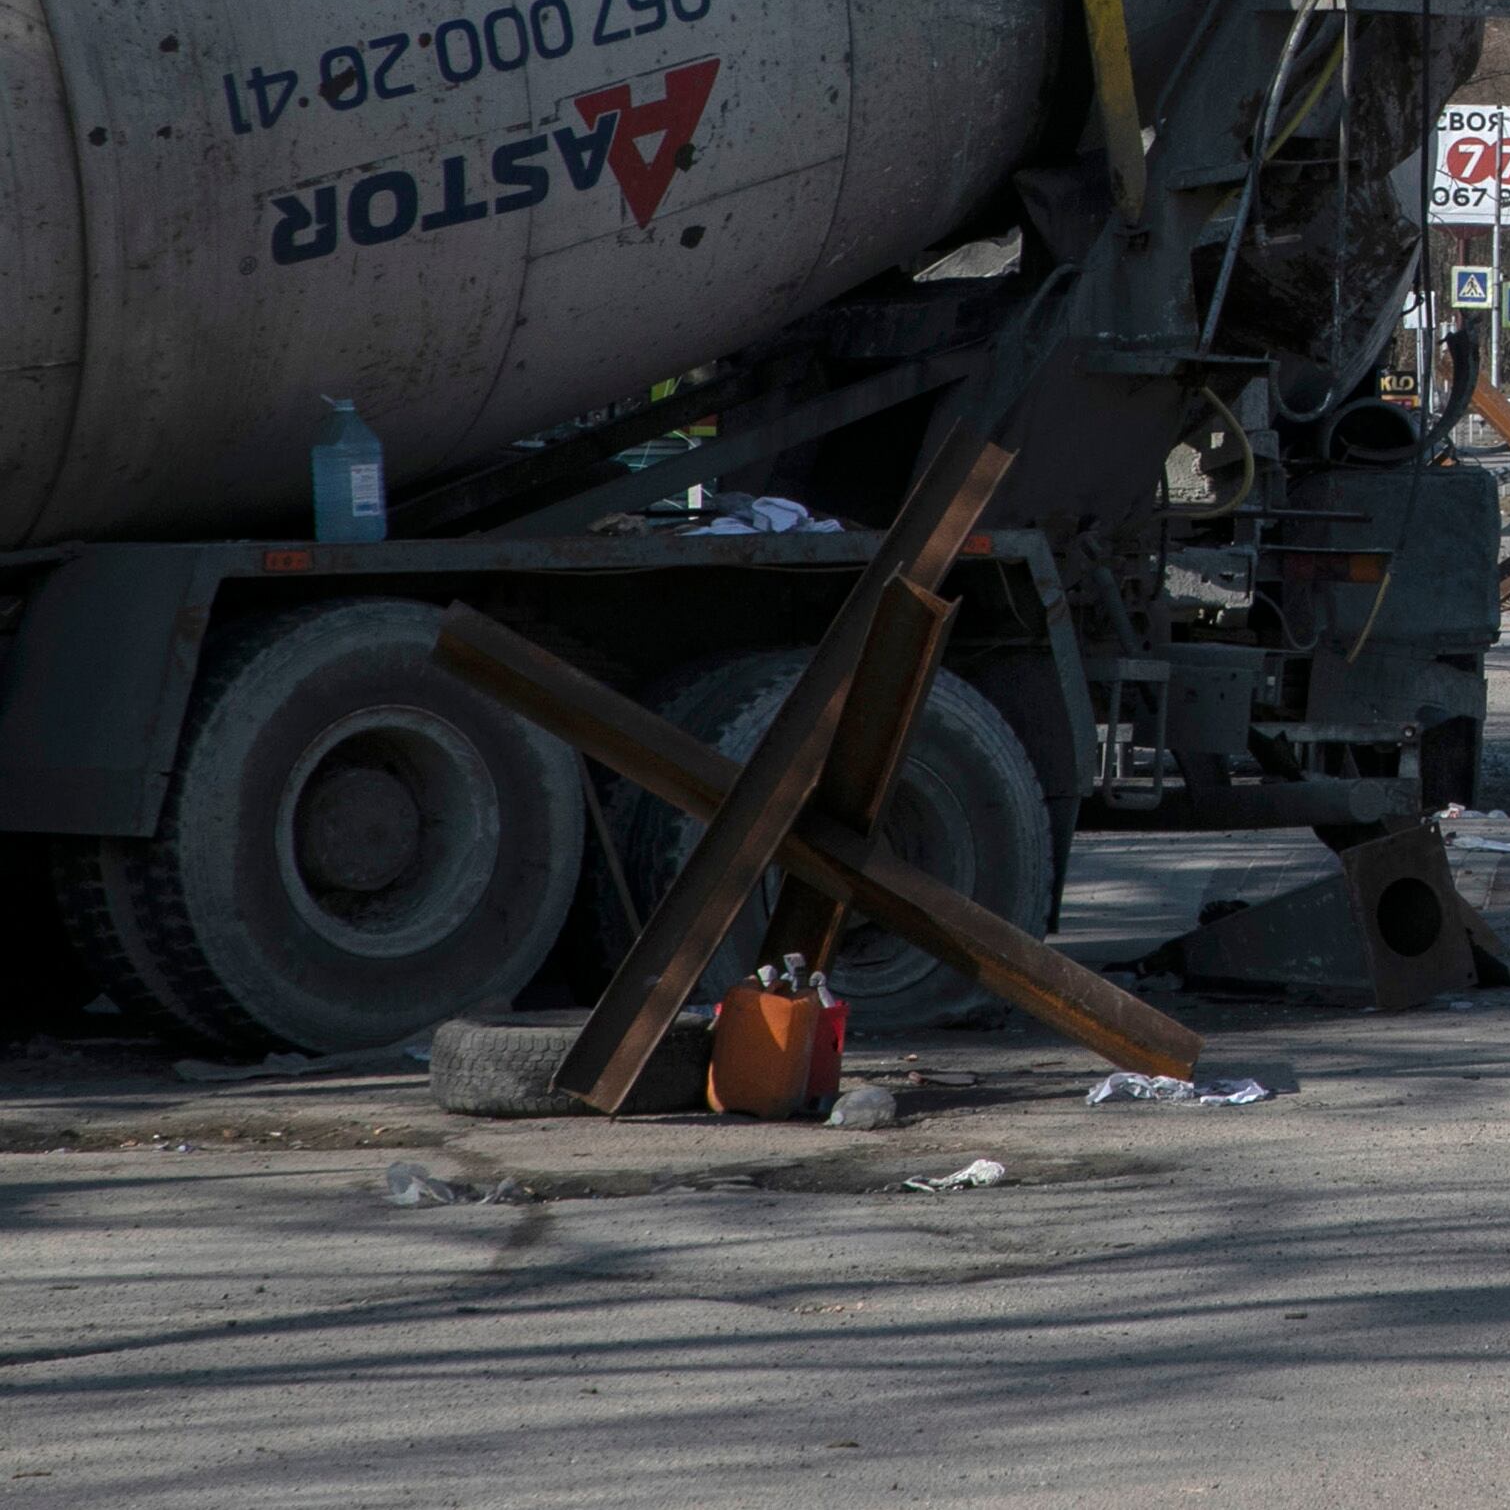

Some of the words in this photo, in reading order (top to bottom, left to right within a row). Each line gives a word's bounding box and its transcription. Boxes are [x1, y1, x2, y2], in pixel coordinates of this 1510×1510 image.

[1436, 112, 1503, 132] СВОЯ
[270, 109, 620, 267] ASTOR
[1432, 187, 1488, 207] 067
[1380, 375, 1415, 392] KLO
